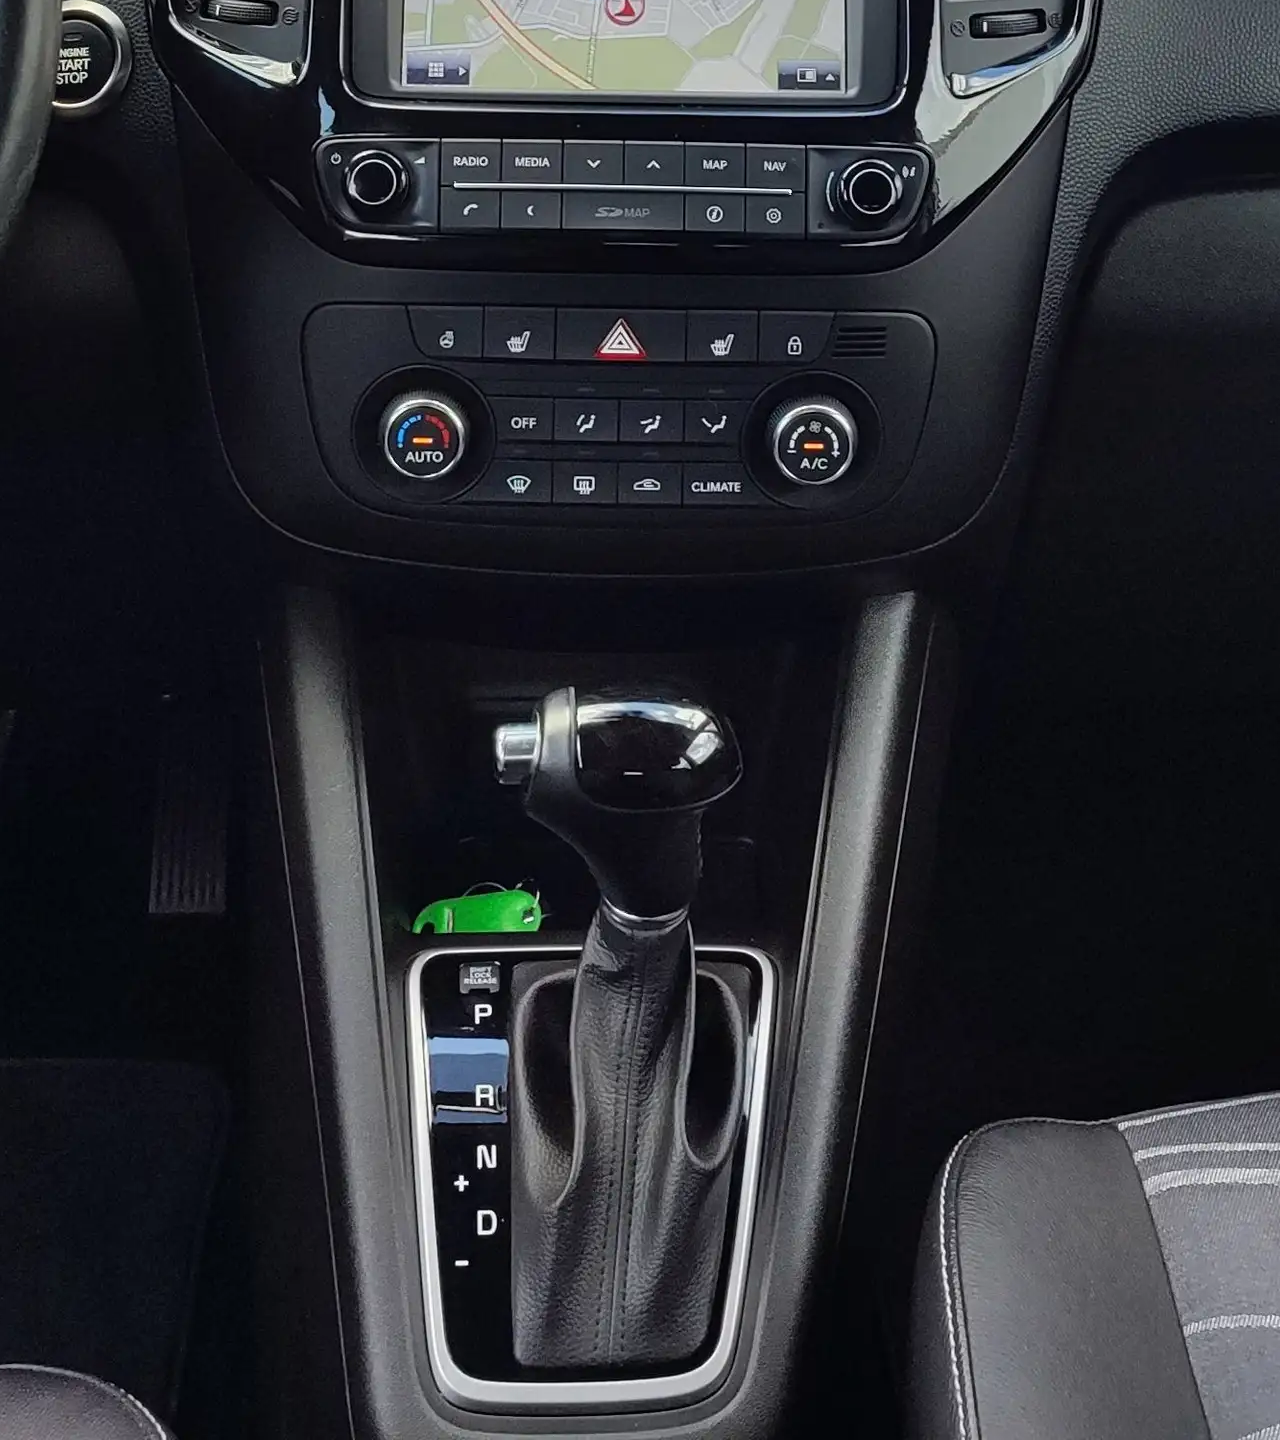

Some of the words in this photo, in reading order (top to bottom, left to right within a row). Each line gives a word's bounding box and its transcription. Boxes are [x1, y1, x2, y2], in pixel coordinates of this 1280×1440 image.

[58, 46, 90, 58] NGINE
[55, 71, 89, 85] STOP
[453, 156, 489, 167] RADIO
[514, 157, 550, 168] MEDIA
[702, 159, 728, 171] MAP
[763, 161, 787, 172] NAV
[624, 208, 651, 218] MAP
[510, 417, 537, 429] OFF
[404, 451, 444, 463] AUTO
[800, 458, 829, 470] A/C
[691, 481, 742, 493] CLIMATE
[474, 1003, 493, 1025] P
[475, 1084, 495, 1107] R
[476, 1144, 498, 1170] N
[476, 1210, 498, 1236] D
